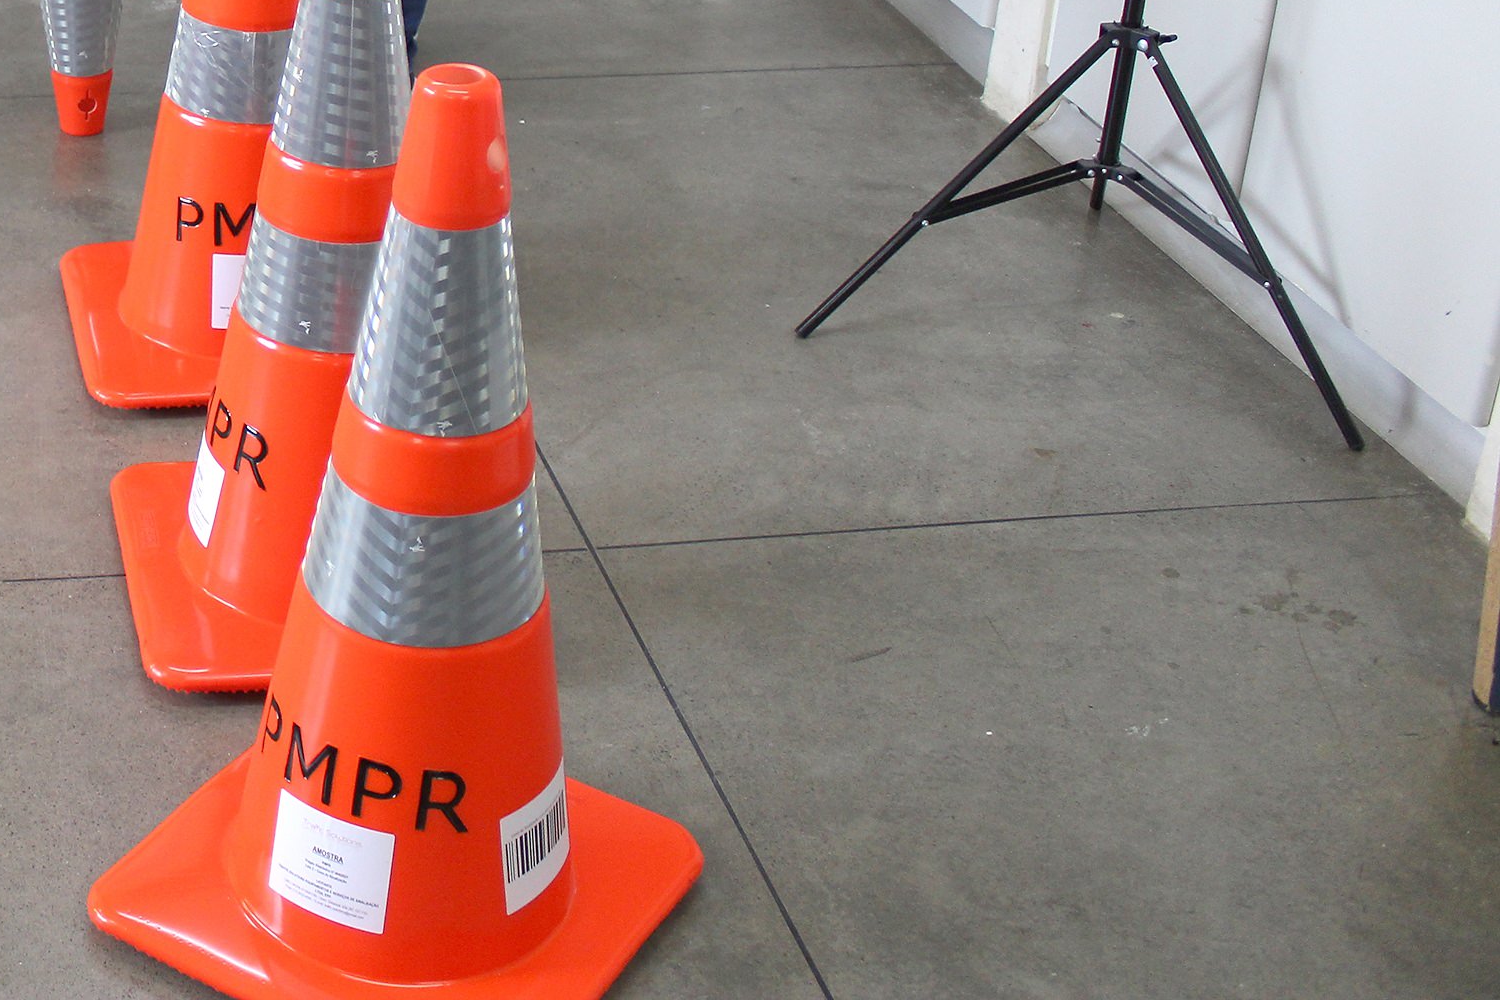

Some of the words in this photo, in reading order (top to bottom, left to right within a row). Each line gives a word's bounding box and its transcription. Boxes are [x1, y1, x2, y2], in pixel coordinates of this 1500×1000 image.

[206, 386, 269, 492] PR
[261, 693, 469, 833] PMPR
[312, 846, 344, 864] AMOSTRA
